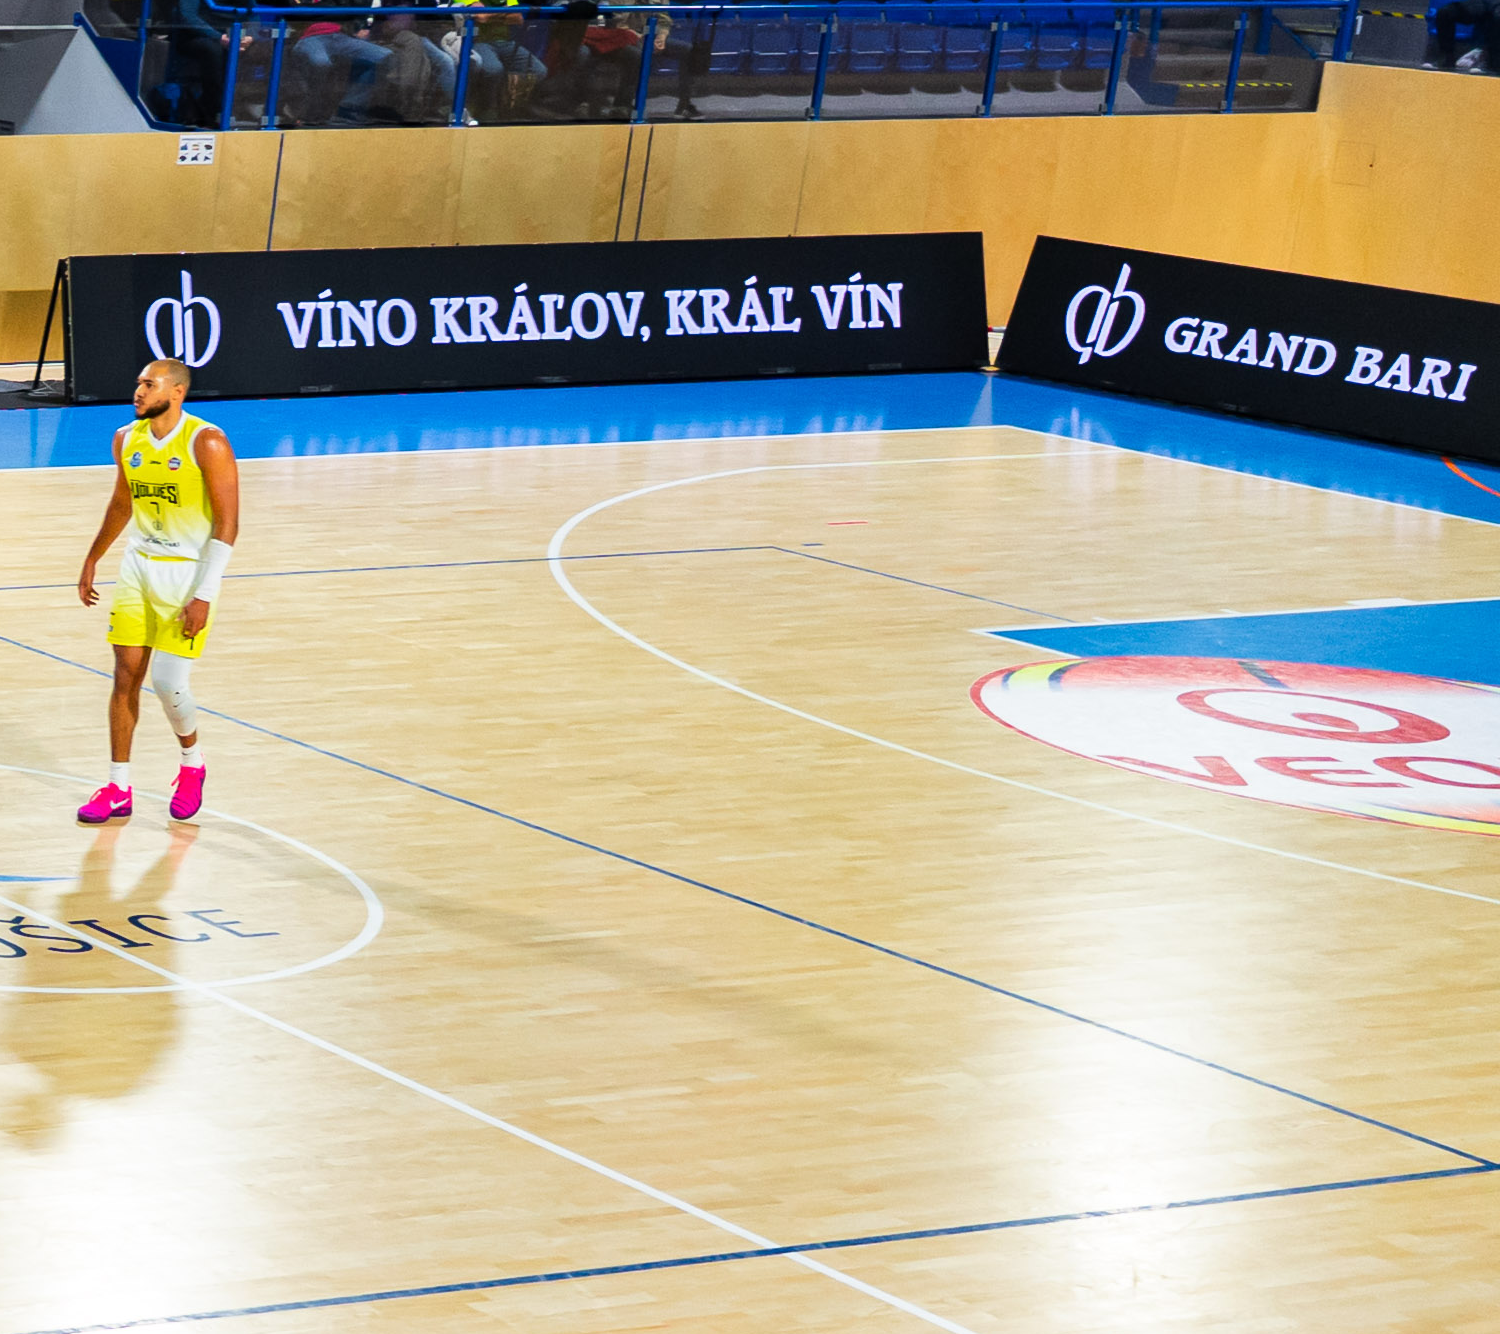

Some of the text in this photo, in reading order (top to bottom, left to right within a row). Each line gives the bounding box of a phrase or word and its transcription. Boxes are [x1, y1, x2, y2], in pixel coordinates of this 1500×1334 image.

[277, 272, 903, 350] VÍNO KRÁĽOV, KRÁĽ VÍN
[1164, 315, 1476, 403] GRAND BARI
[130, 480, 178, 504] WOLVES
[150, 502, 160, 515] 7
